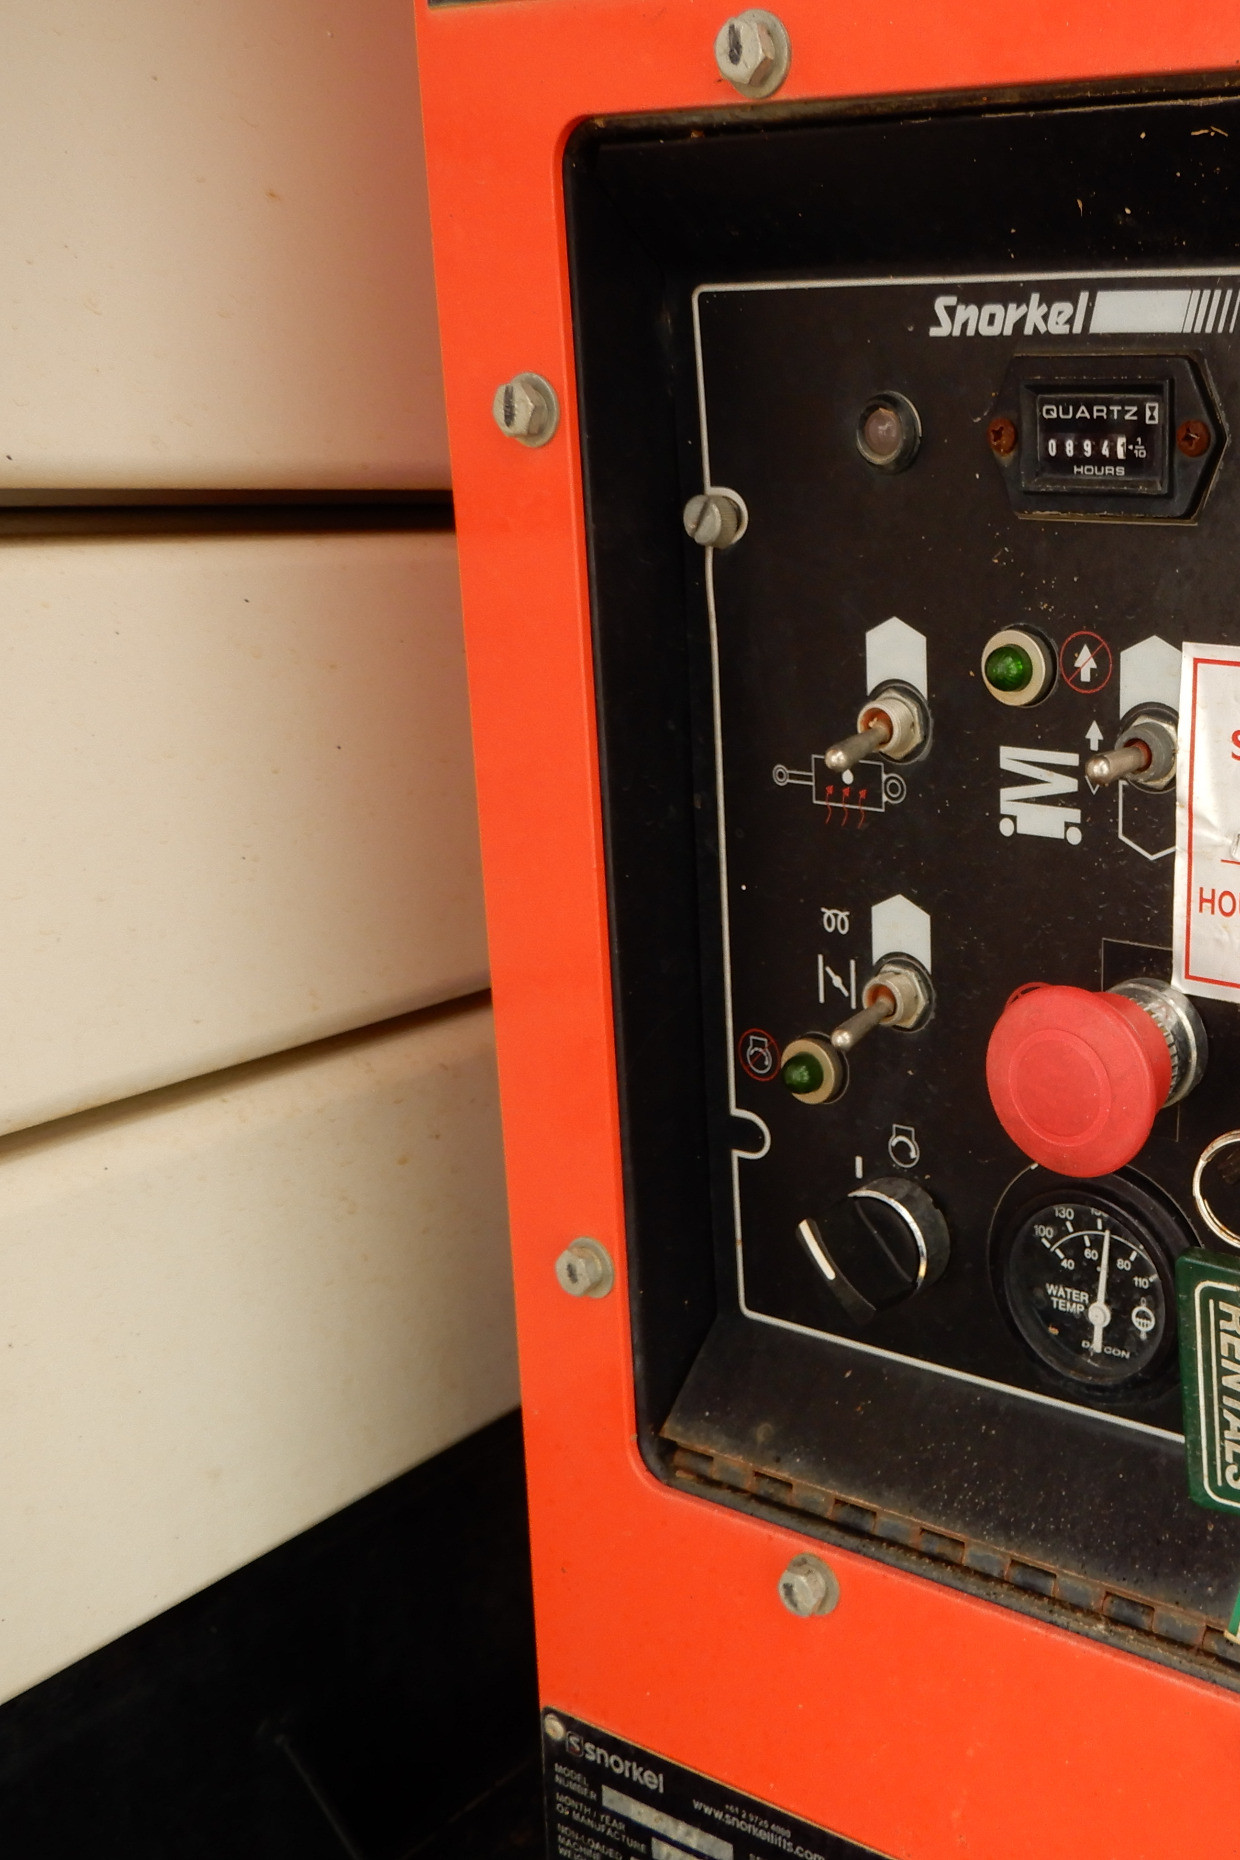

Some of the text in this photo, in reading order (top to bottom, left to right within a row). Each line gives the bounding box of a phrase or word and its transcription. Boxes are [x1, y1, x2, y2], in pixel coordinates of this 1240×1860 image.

[929, 291, 1090, 337] Snorkel
[1042, 404, 1138, 420] QUARTZ
[1073, 465, 1126, 477] HOURS
[1054, 1206, 1075, 1221] 130
[1034, 1224, 1054, 1239] 100
[1084, 1249, 1099, 1261] 60
[1060, 1258, 1075, 1271] 40
[1116, 1258, 1131, 1271] 80
[1132, 1276, 1150, 1290] 110
[1045, 1283, 1089, 1306] WATER
[1050, 1296, 1085, 1315] TEMP
[1081, 1340, 1131, 1359] DCON
[554, 1763, 587, 1786] MODEL
[584, 1742, 664, 1794] snorkel
[555, 1774, 597, 1801] NUMBER
